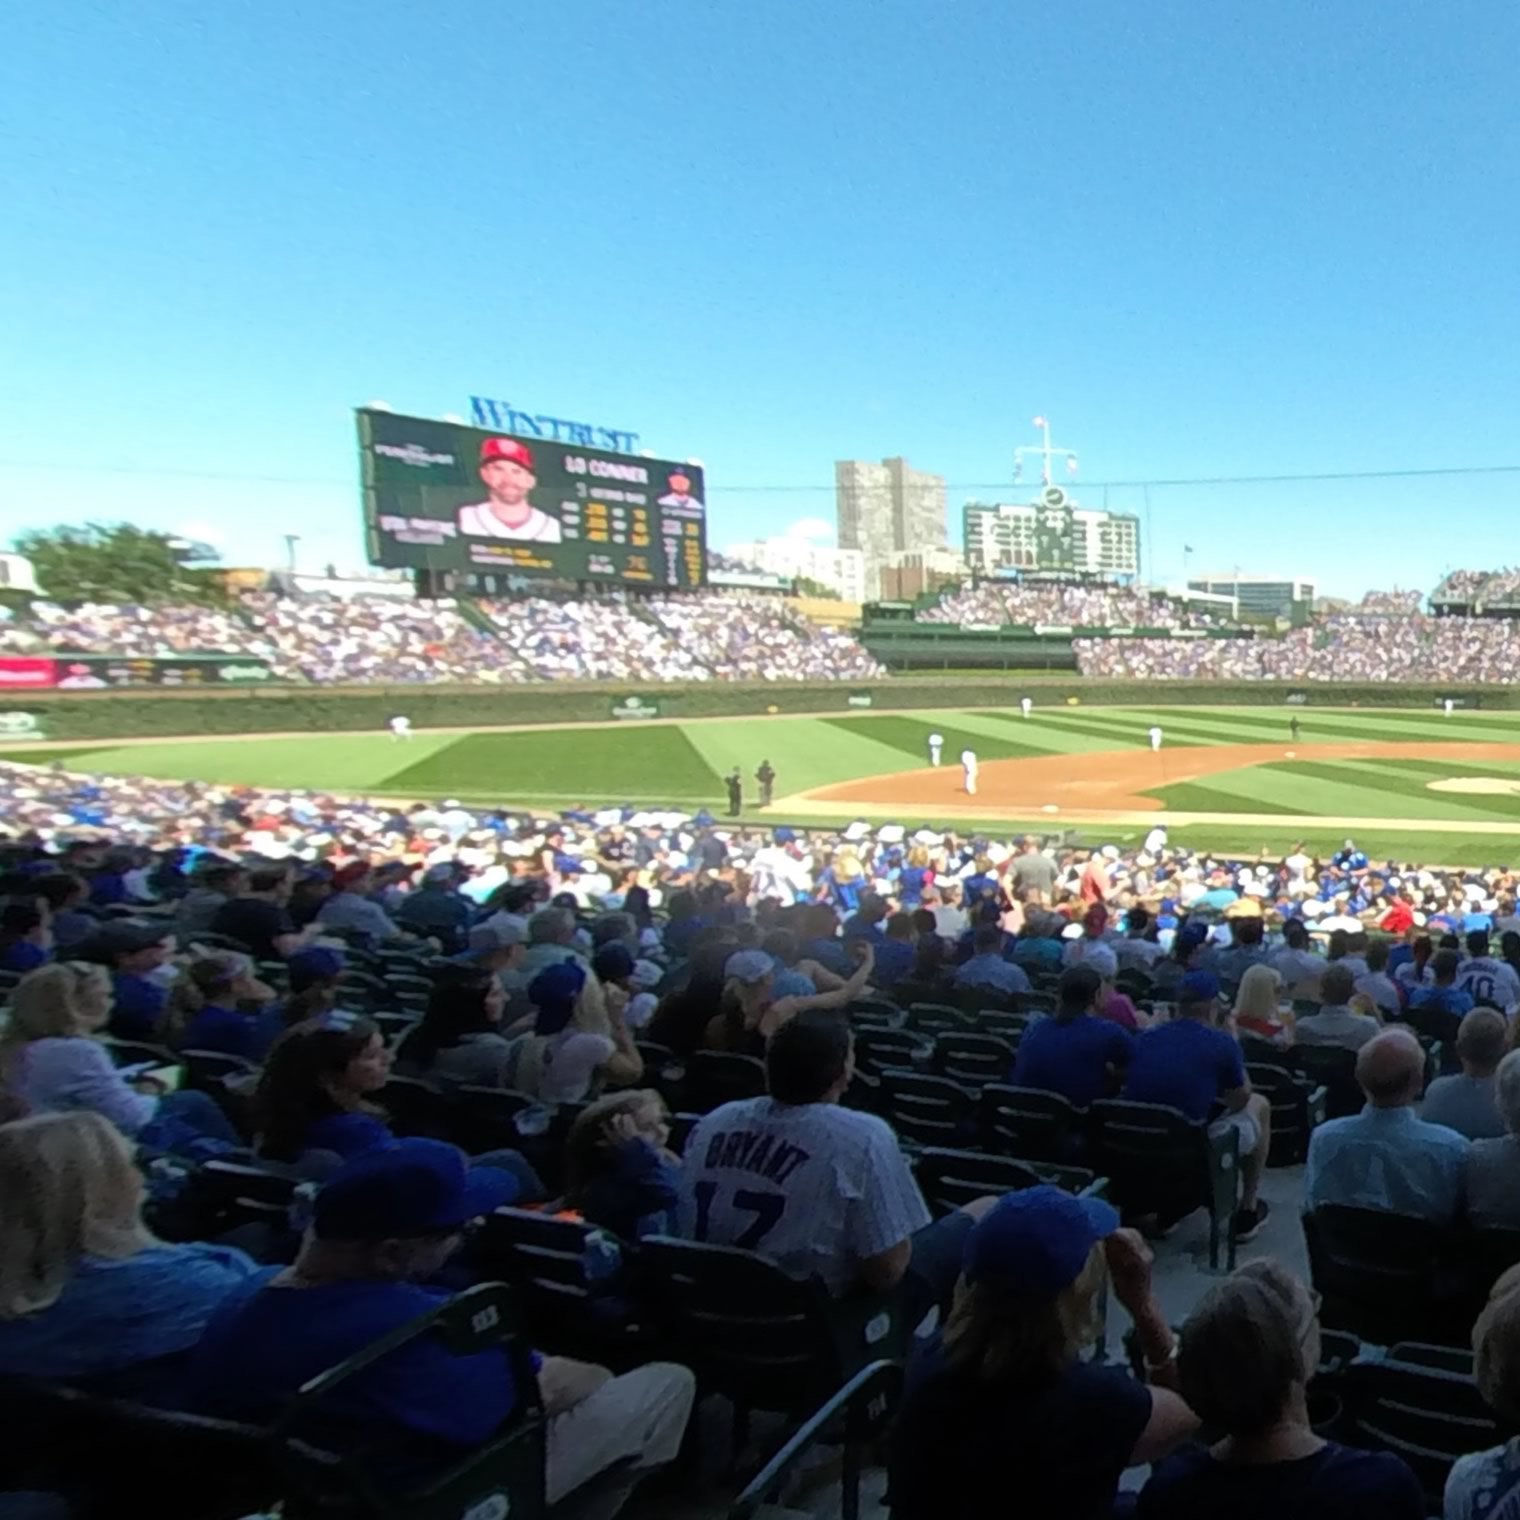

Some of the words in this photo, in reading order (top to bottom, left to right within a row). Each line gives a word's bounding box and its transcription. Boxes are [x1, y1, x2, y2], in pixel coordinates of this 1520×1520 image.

[470, 395, 640, 453] WINTRUST
[704, 1131, 811, 1186] BRYANT
[694, 1181, 786, 1250] 17
